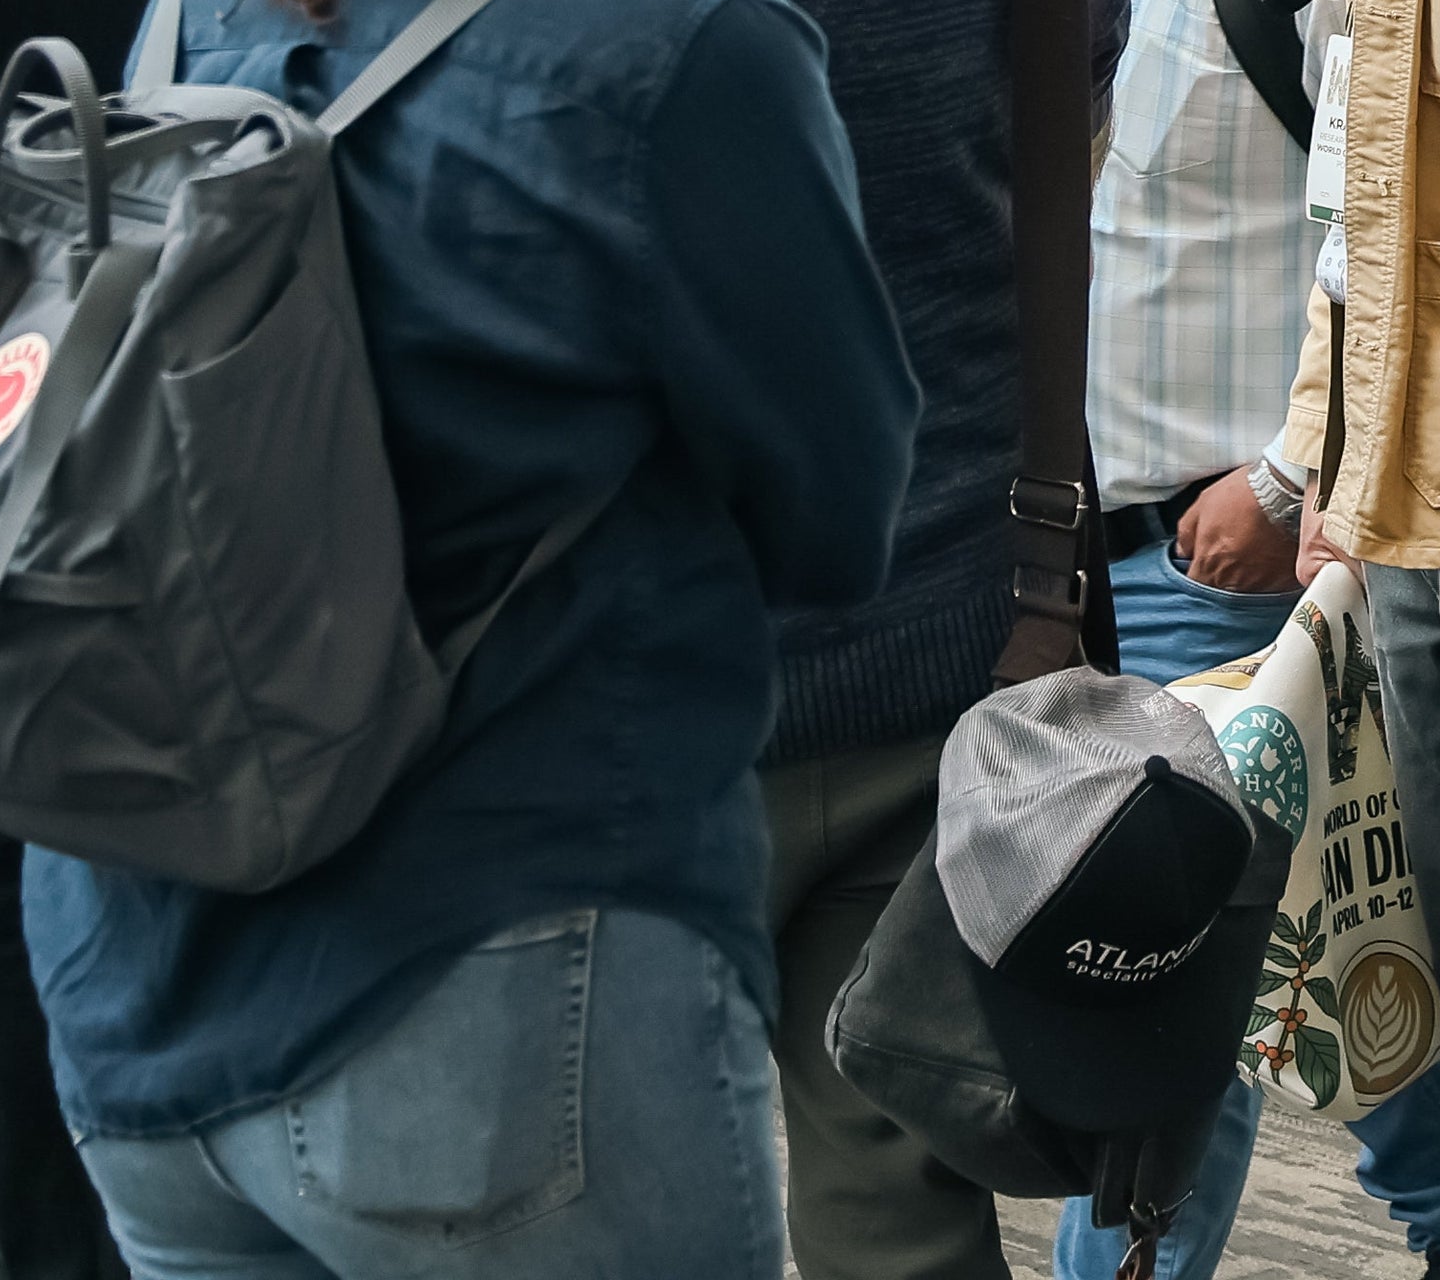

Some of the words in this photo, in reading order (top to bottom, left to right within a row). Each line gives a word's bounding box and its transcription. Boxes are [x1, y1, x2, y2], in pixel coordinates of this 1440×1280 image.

[1316, 143, 1342, 156] WORLD
[1323, 799, 1361, 840] WORLD
[1365, 791, 1387, 818] OF
[1320, 836, 1355, 911] AN
[1363, 820, 1414, 887] DI
[1333, 902, 1365, 938] APRIL
